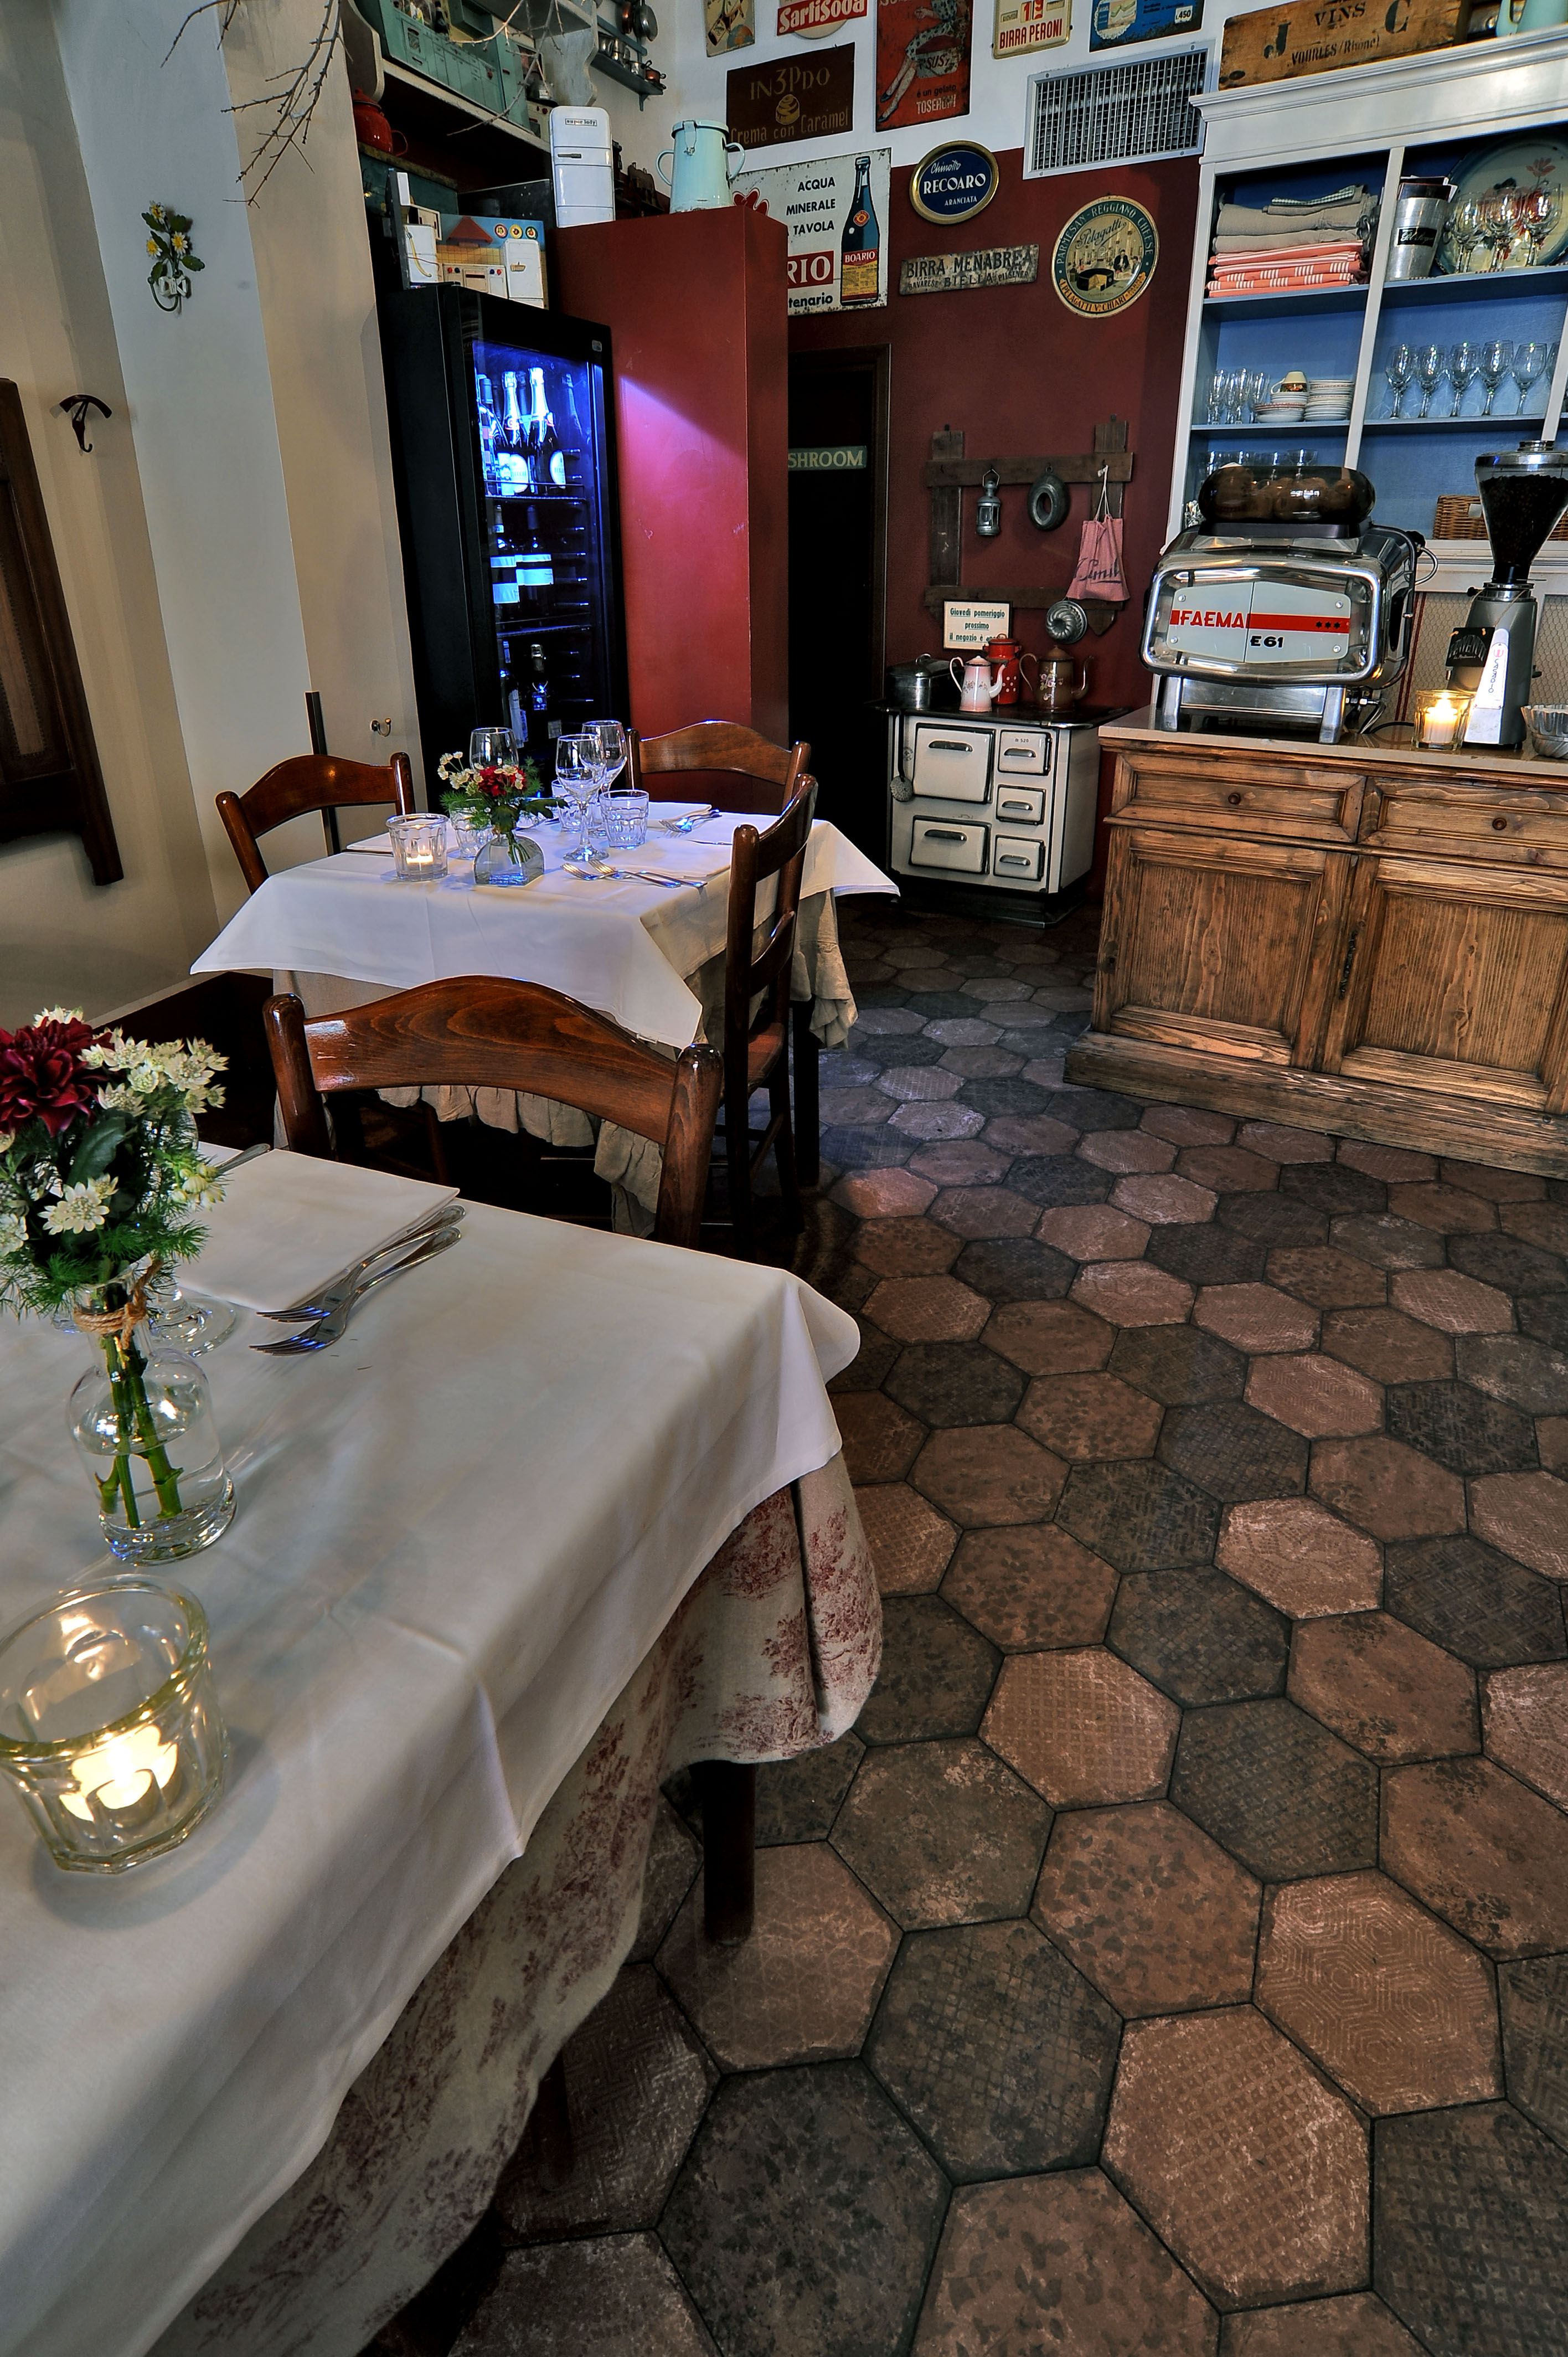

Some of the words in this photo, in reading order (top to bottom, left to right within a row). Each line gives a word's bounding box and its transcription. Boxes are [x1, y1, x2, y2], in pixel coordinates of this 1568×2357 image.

[1315, 2, 1366, 25] VINS
[999, 27, 1027, 49] BIRRA
[1029, 18, 1062, 43] PERONI
[926, 55, 950, 69] SUSY
[731, 126, 767, 145] Crema
[773, 125, 795, 138] con
[801, 106, 848, 133] Caramel
[797, 177, 835, 192] ACQUA
[924, 173, 986, 194] RECOARO
[786, 199, 835, 215] MINERALE
[945, 195, 977, 206] ARANCIATA
[793, 220, 834, 235] TAVOLA
[1076, 217, 1126, 249] Pelagatti
[1137, 217, 1153, 255] CHEESE
[845, 251, 875, 263] BOARIO
[906, 259, 945, 278] BIRRA
[953, 250, 1032, 272] MENABREA
[974, 609, 1005, 618] pomeriggio
[1180, 610, 1244, 629] FAEMA
[956, 634, 977, 642] negozio
